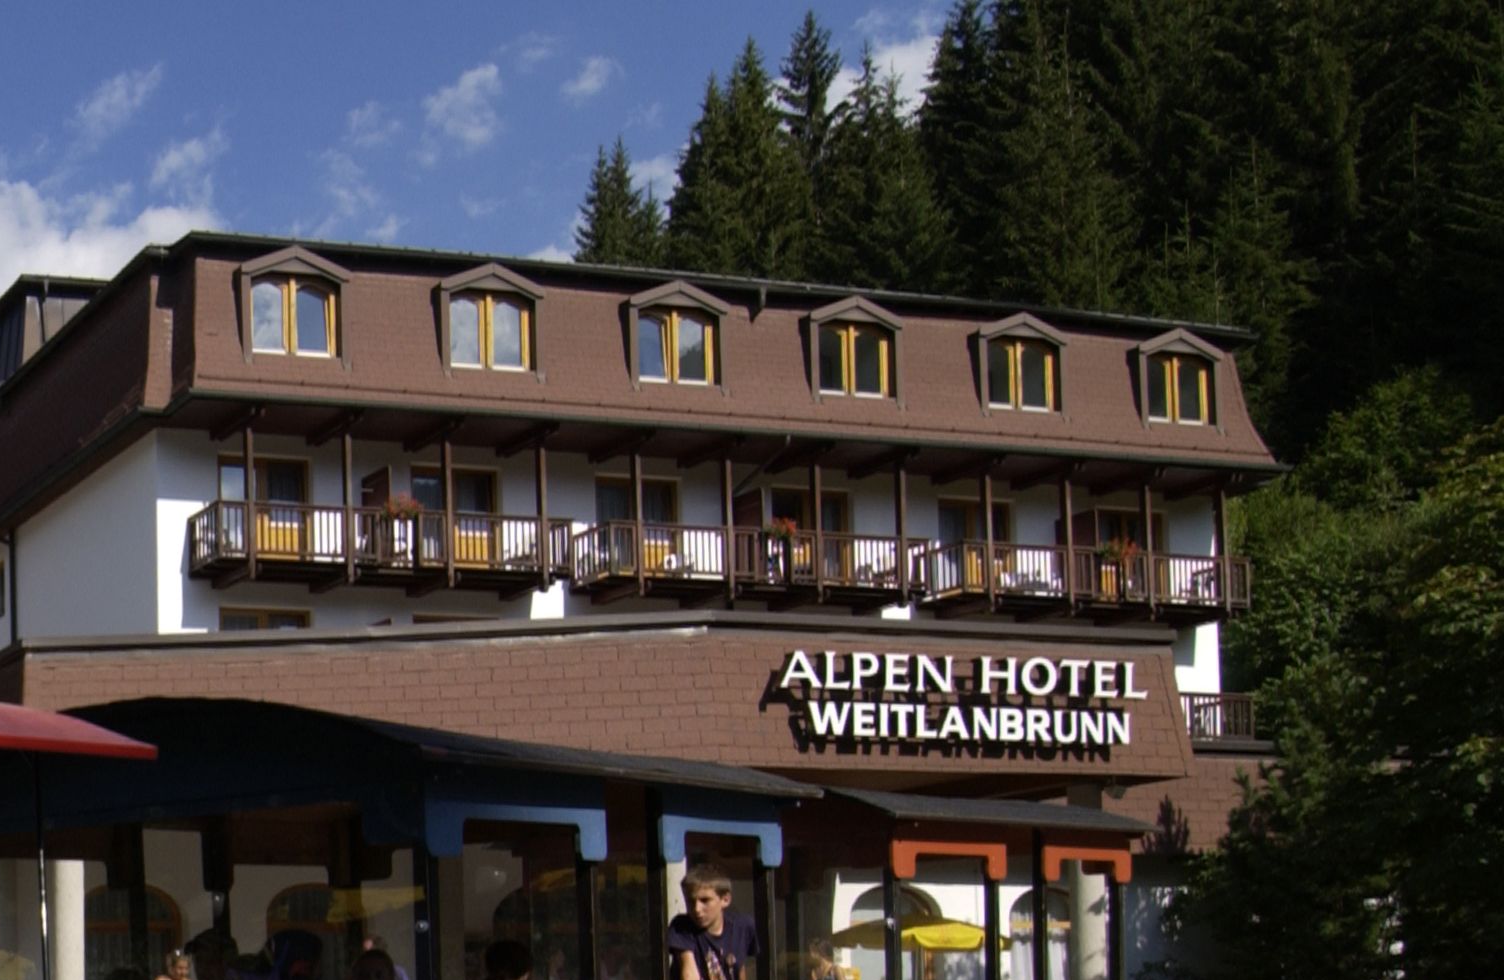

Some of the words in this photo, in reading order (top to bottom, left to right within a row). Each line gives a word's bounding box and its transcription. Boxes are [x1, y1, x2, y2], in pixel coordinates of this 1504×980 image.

[781, 649, 954, 694] ALPEN
[981, 656, 1148, 700] HOTEL
[808, 701, 1131, 744] WEITLANBRUNN
